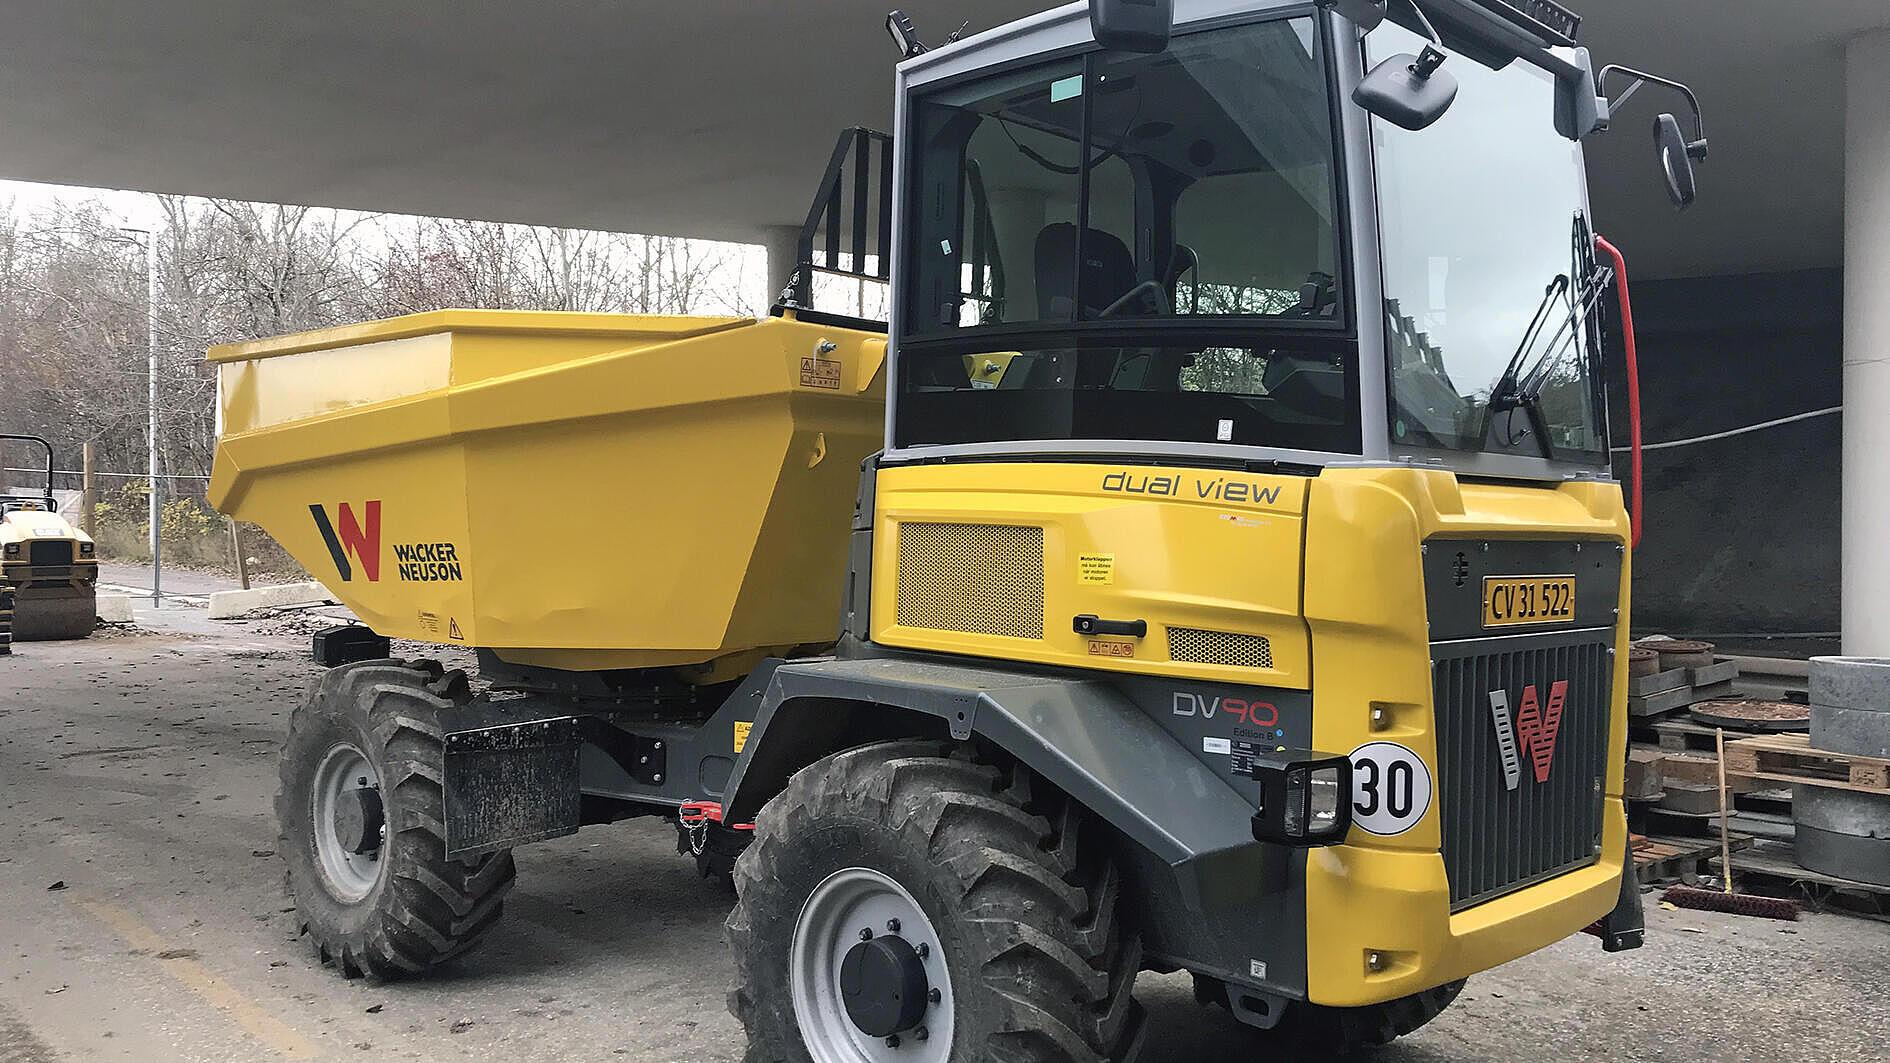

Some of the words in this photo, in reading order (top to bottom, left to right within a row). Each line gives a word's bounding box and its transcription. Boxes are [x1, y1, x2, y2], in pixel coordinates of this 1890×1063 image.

[1102, 471, 1181, 496] dual
[1196, 478, 1281, 504] view
[309, 500, 381, 582] W
[393, 543, 459, 563] WACKER
[398, 562, 463, 581] NEUSON
[1492, 585, 1516, 619] CV
[1519, 584, 1536, 617] 31
[1541, 583, 1570, 616] 522
[1173, 691, 1279, 727] DV90
[1233, 727, 1265, 739] Edition
[1267, 732, 1274, 740] B
[1353, 757, 1414, 819] 30
